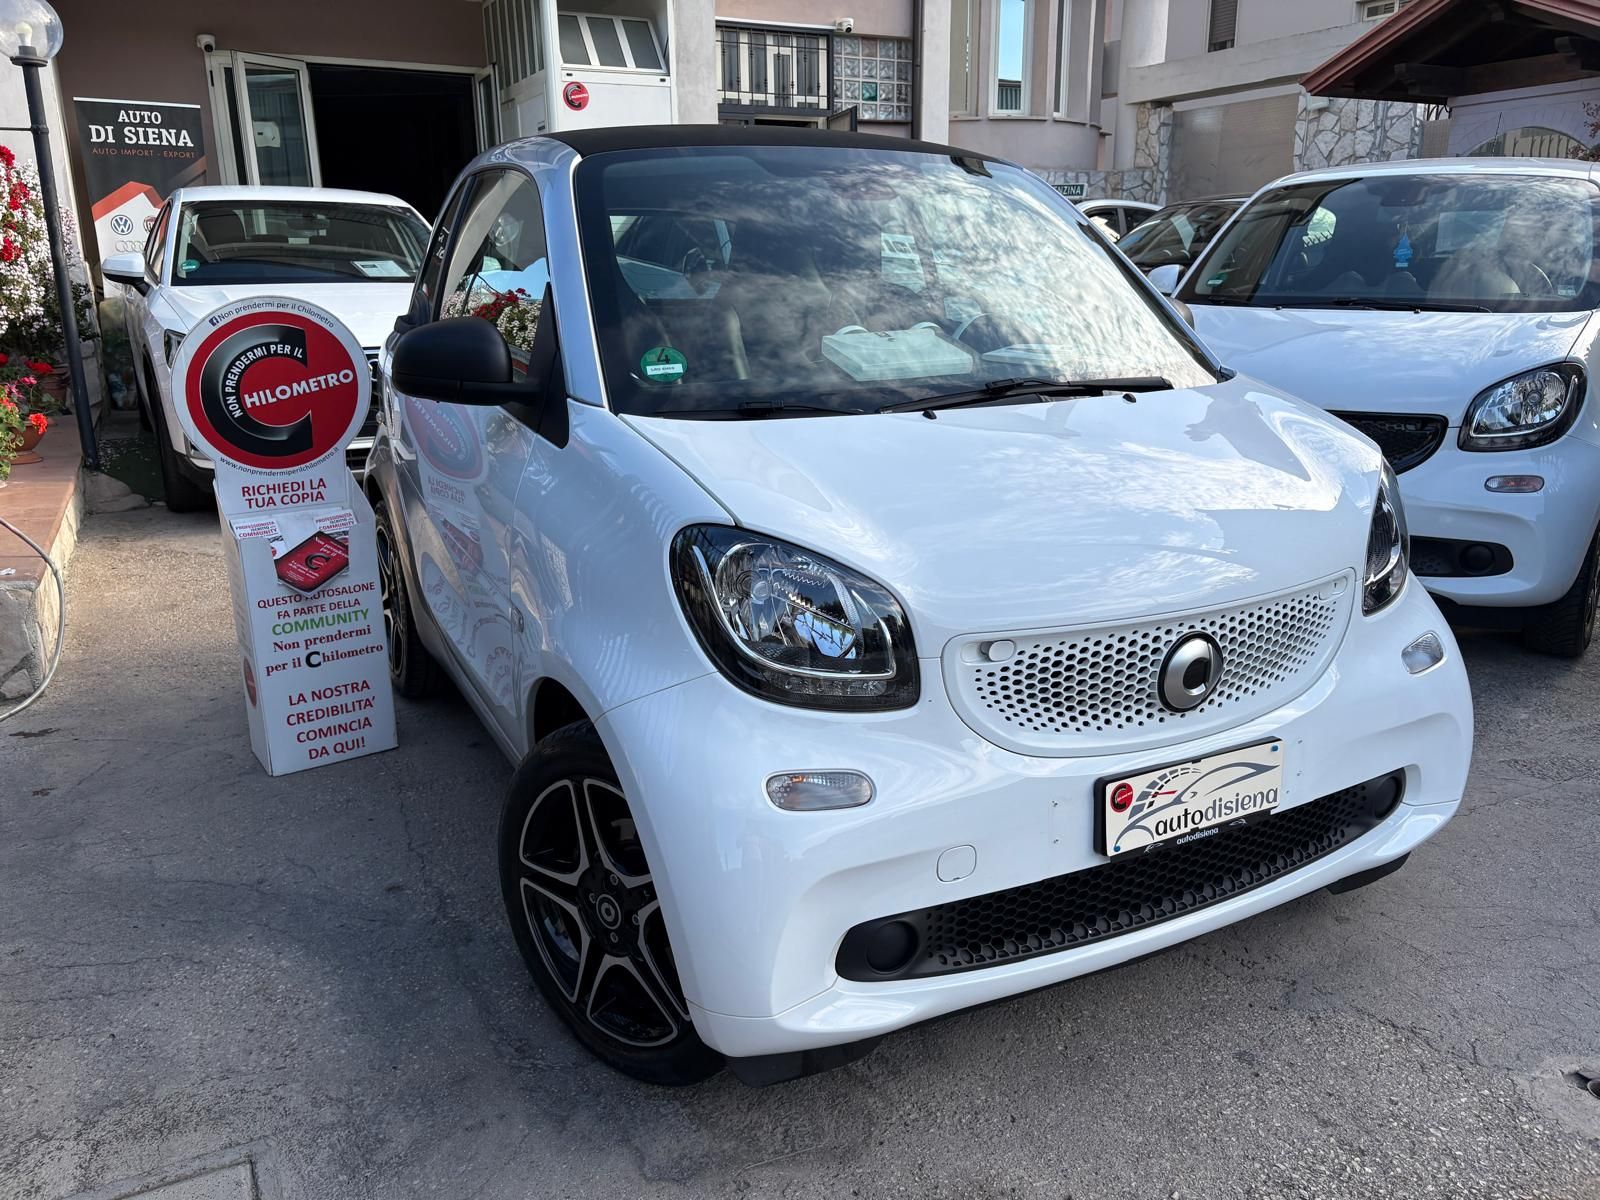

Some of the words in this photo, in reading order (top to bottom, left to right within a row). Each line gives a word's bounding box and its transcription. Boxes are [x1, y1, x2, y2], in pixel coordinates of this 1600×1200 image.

[117, 110, 162, 124] AUTO
[88, 125, 115, 143] DI
[124, 126, 194, 147] SIENA
[91, 147, 118, 156] AUTO
[121, 148, 154, 157] IMPORT
[163, 150, 195, 159] EXPORT
[217, 310, 235, 322] Non
[234, 301, 275, 314] prendermi
[297, 305, 335, 328] Chilometro
[270, 344, 292, 355] PER
[293, 346, 303, 359] IL
[656, 347, 671, 364] 4
[225, 346, 268, 393] PRENDERMI
[225, 396, 244, 418] NON
[241, 480, 305, 497] RICHIEDI
[309, 477, 327, 490] LA
[245, 496, 277, 509] TUA
[280, 491, 325, 505] COPIA
[257, 594, 302, 609] QUESTO
[277, 609, 291, 620] FA
[293, 603, 327, 617] PARTE
[329, 598, 361, 611] DELLA
[272, 608, 370, 636] COMMUNITY
[273, 641, 301, 653] Non
[304, 625, 371, 650] prendermi
[264, 661, 289, 677] per
[292, 657, 302, 669] il
[305, 643, 384, 668] Chilometro
[288, 691, 307, 706] LA
[311, 679, 371, 702] NOSTRA
[286, 696, 376, 727] CREDIBILITA'
[296, 716, 373, 743] COMINCIA
[308, 746, 330, 760] DA
[333, 736, 366, 754] QUI!
[1154, 787, 1280, 836] autodisiena
[1176, 827, 1219, 845] autodisiena
